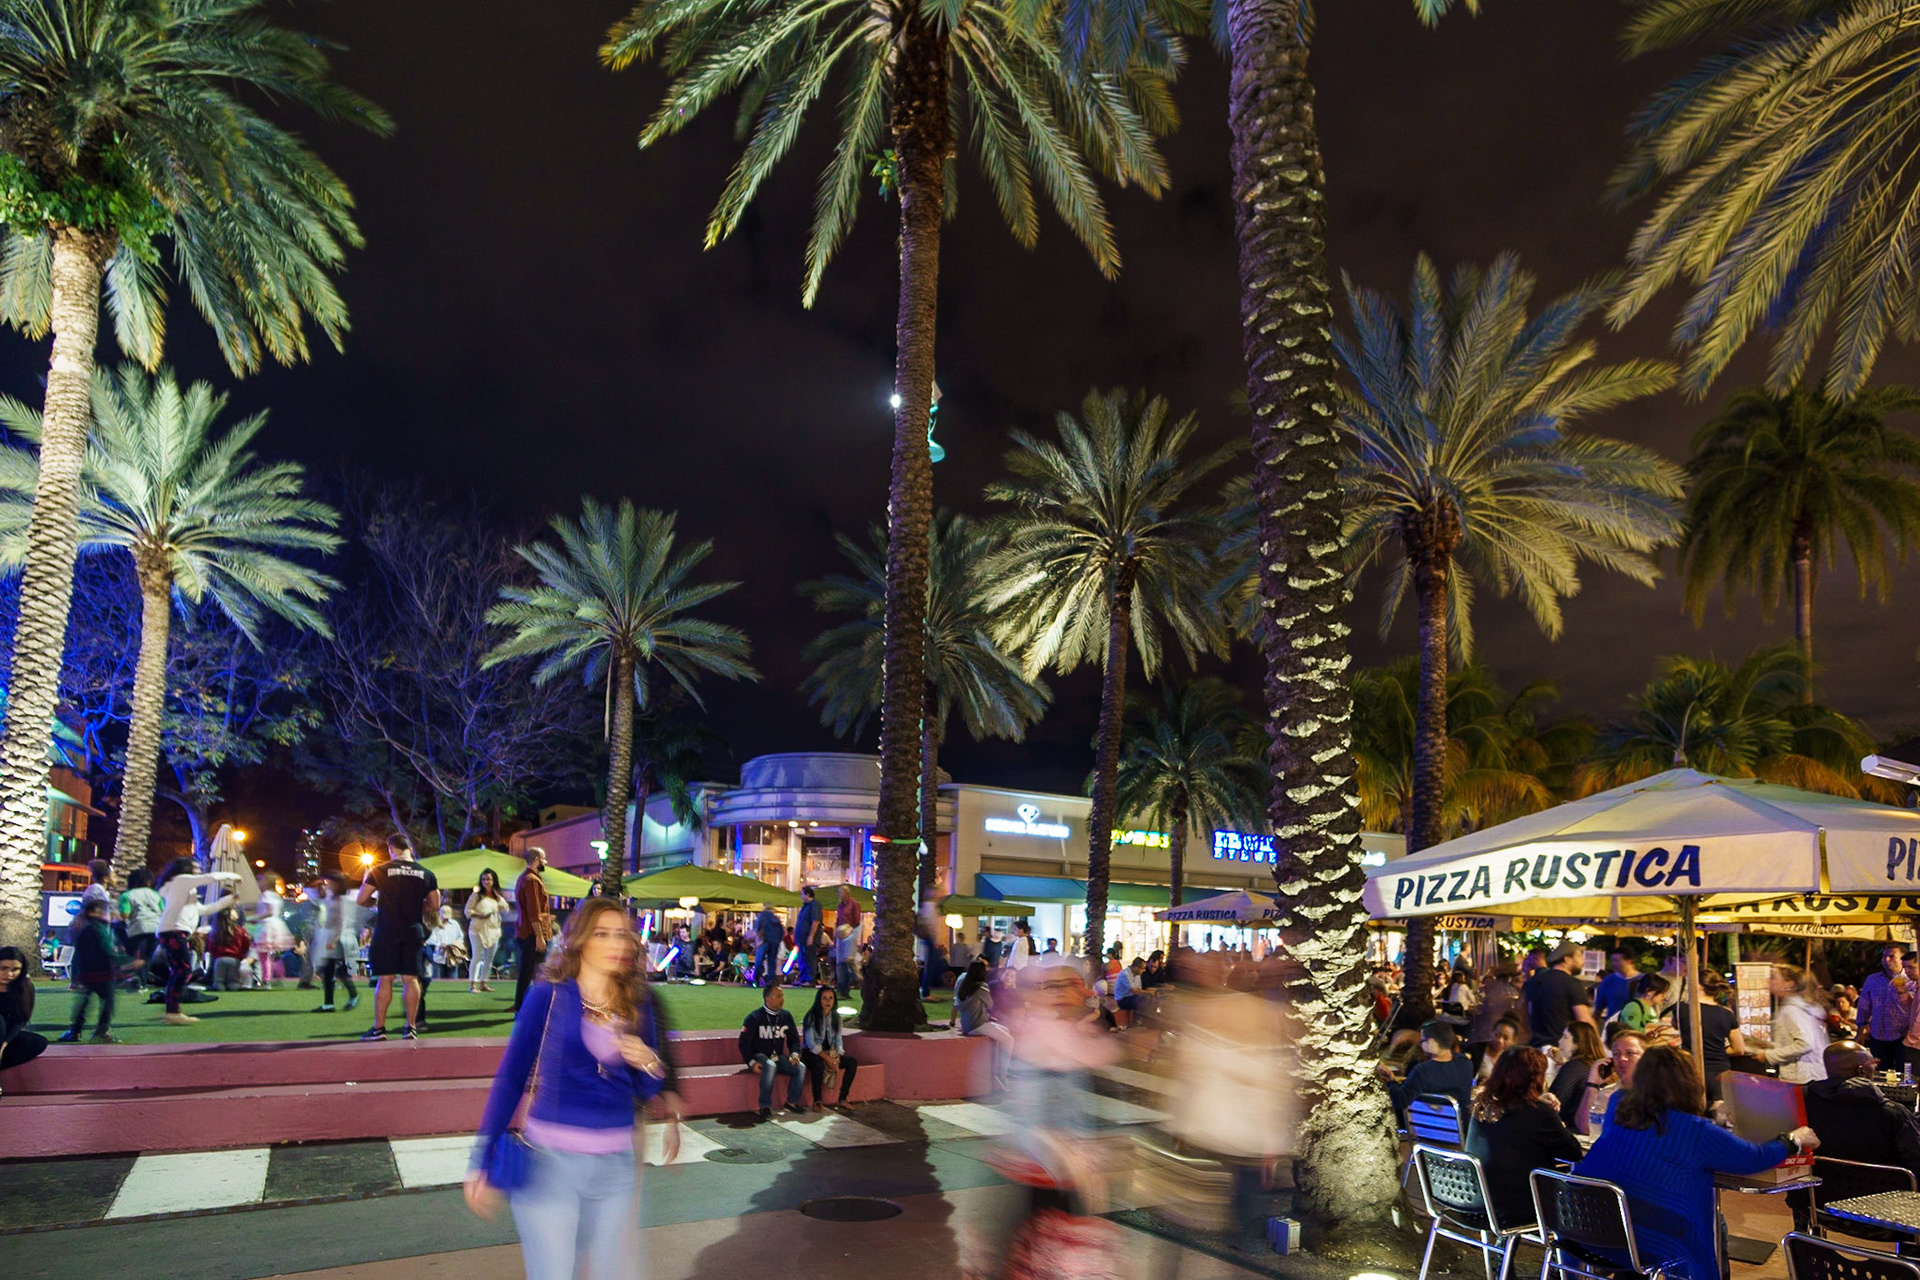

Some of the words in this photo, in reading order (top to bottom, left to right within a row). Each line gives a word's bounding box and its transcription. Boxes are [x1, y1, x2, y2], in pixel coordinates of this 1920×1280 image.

[1213, 847, 1277, 864] EYEWE
[1887, 836, 1920, 881] PI
[1394, 866, 1491, 910] PIZZA
[1503, 845, 1701, 894] RUSTICA
[1167, 911, 1194, 921] PIZZA
[1196, 910, 1237, 920] RUSTICA
[1435, 915, 1495, 929] RUSTICA
